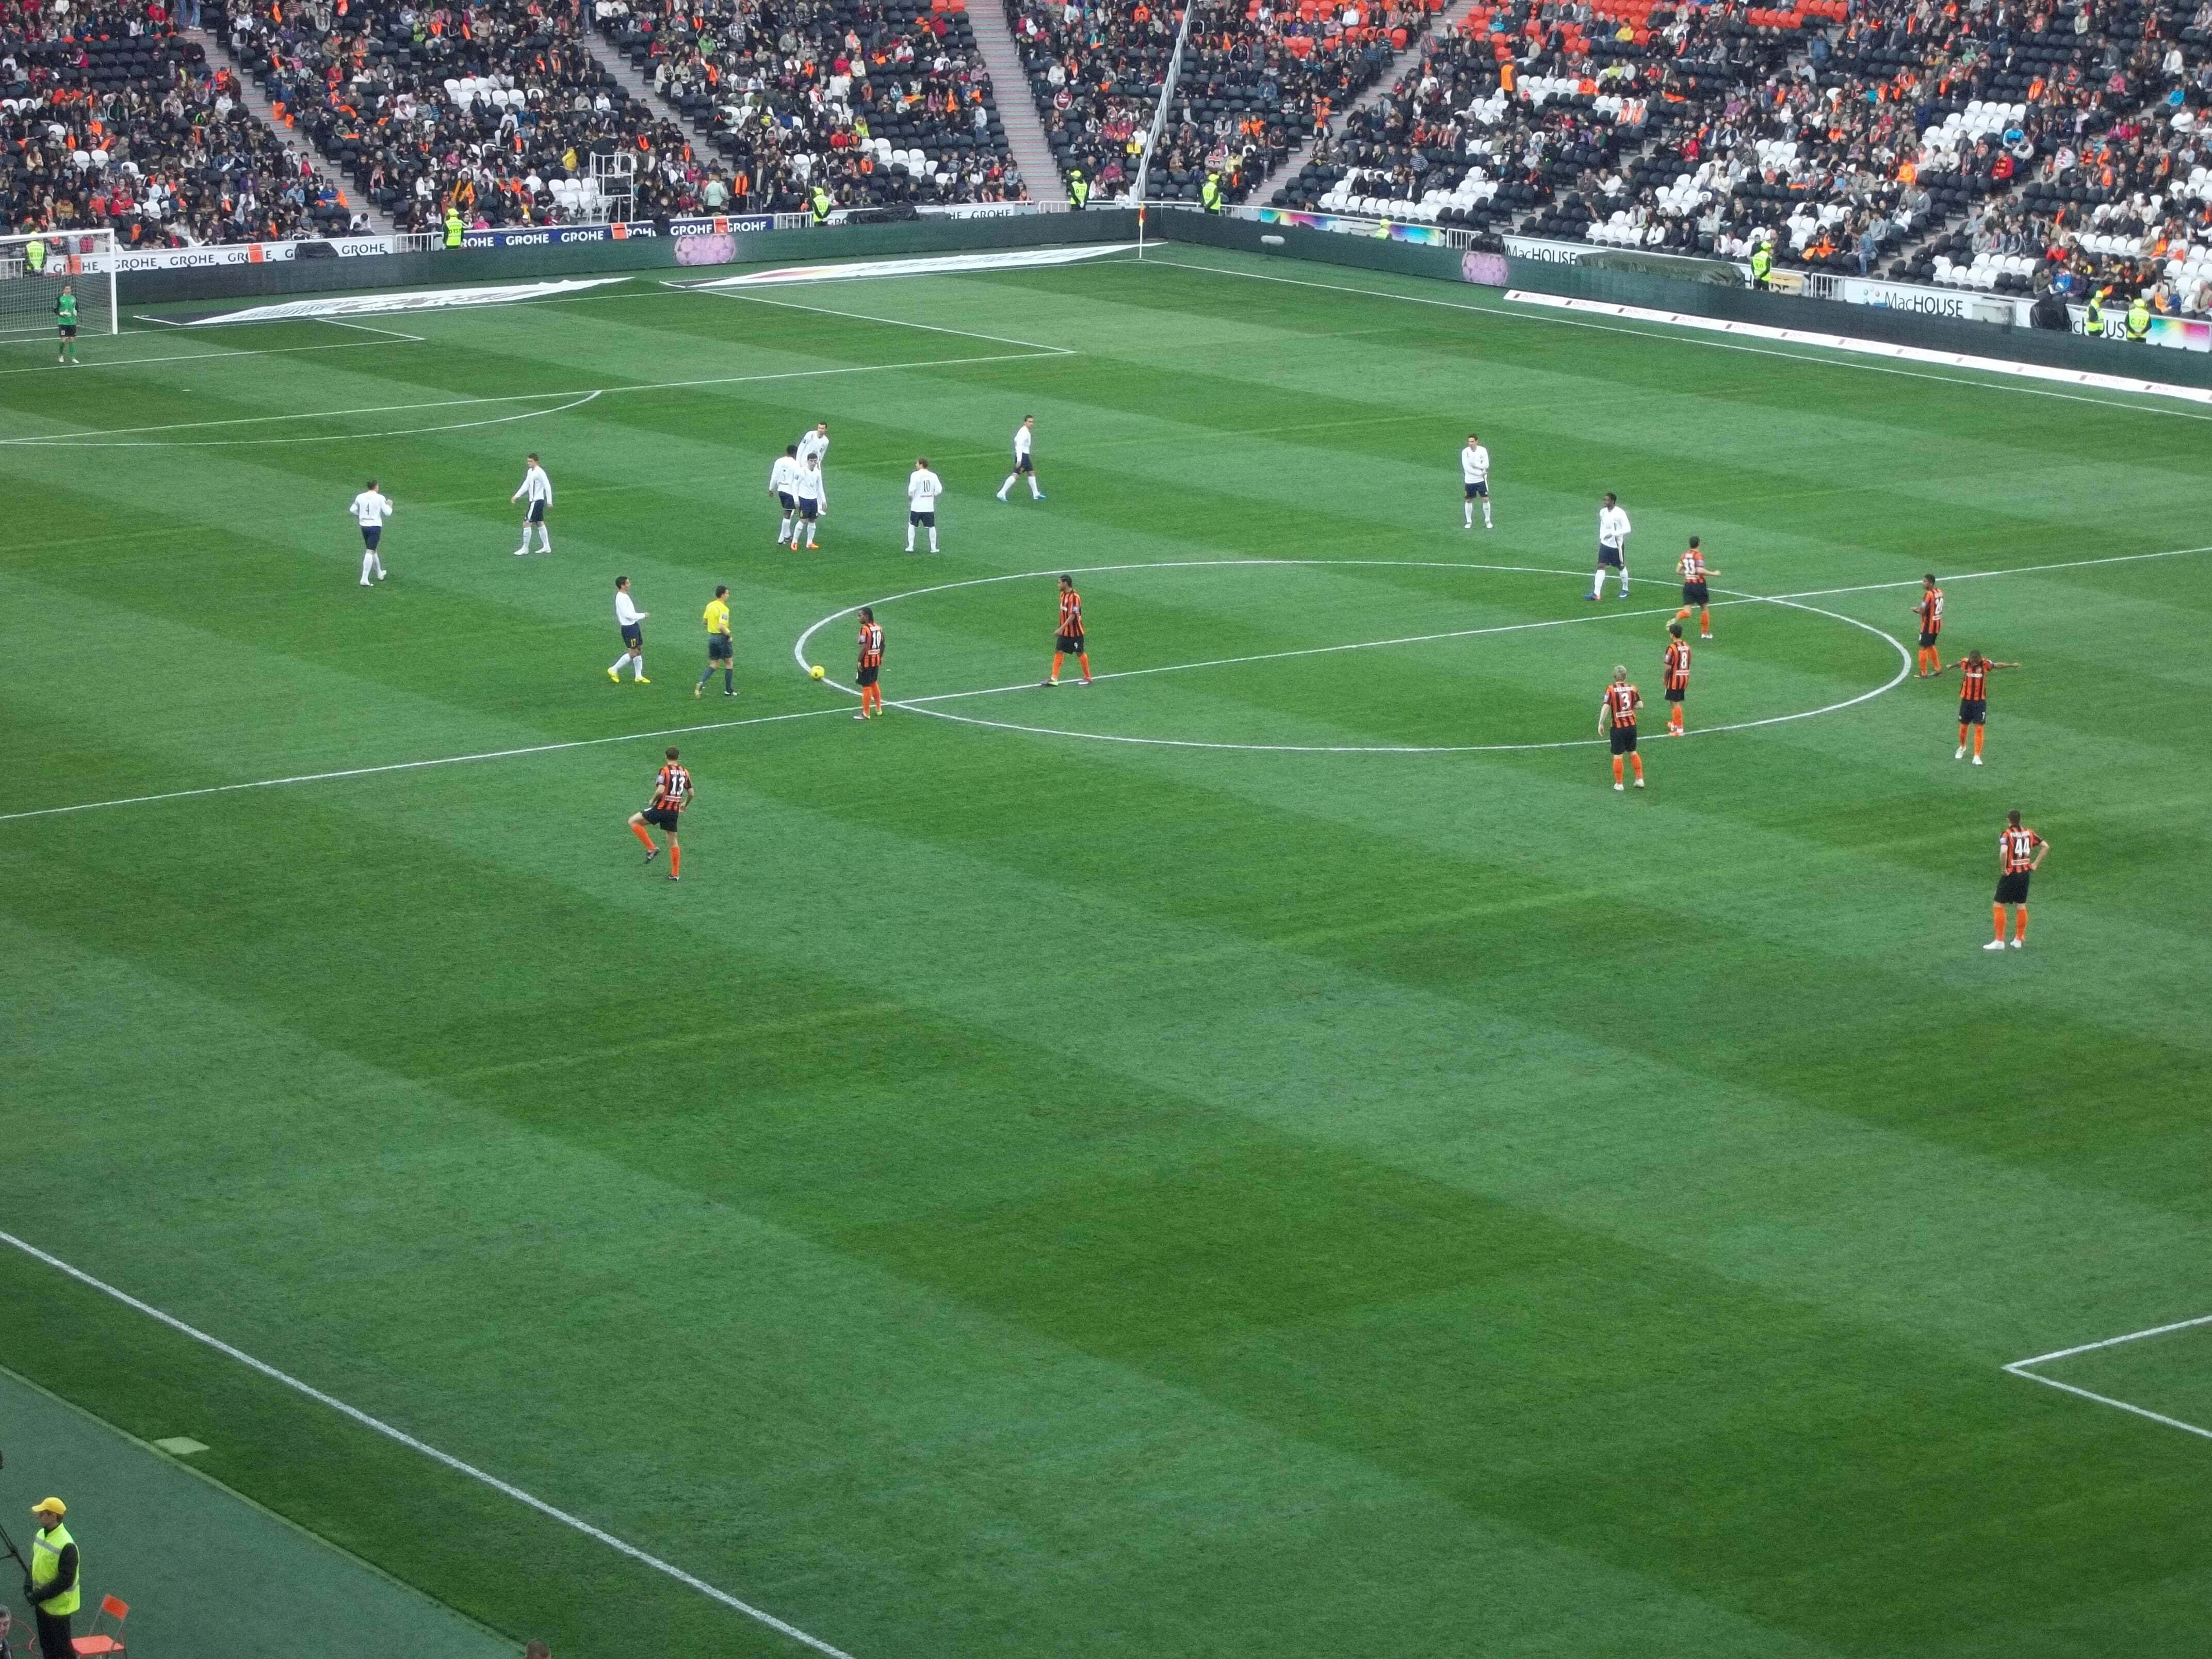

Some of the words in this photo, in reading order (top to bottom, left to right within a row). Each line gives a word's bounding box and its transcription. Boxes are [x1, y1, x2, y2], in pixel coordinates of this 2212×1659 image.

[461, 237, 494, 248] ROHE
[506, 234, 549, 246] GROHE
[561, 230, 604, 242] GROHE
[227, 250, 272, 262] GRE
[341, 243, 385, 256] GROHE
[170, 254, 215, 266] GROHE
[53, 262, 99, 272] GHE
[1885, 291, 1963, 318] MacHOUSE
[923, 479, 930, 493] 10
[872, 631, 881, 649] 10
[1681, 652, 1687, 669] 8
[1621, 692, 1631, 711] 3
[670, 776, 686, 795] 13
[2014, 837, 2031, 858] 44
